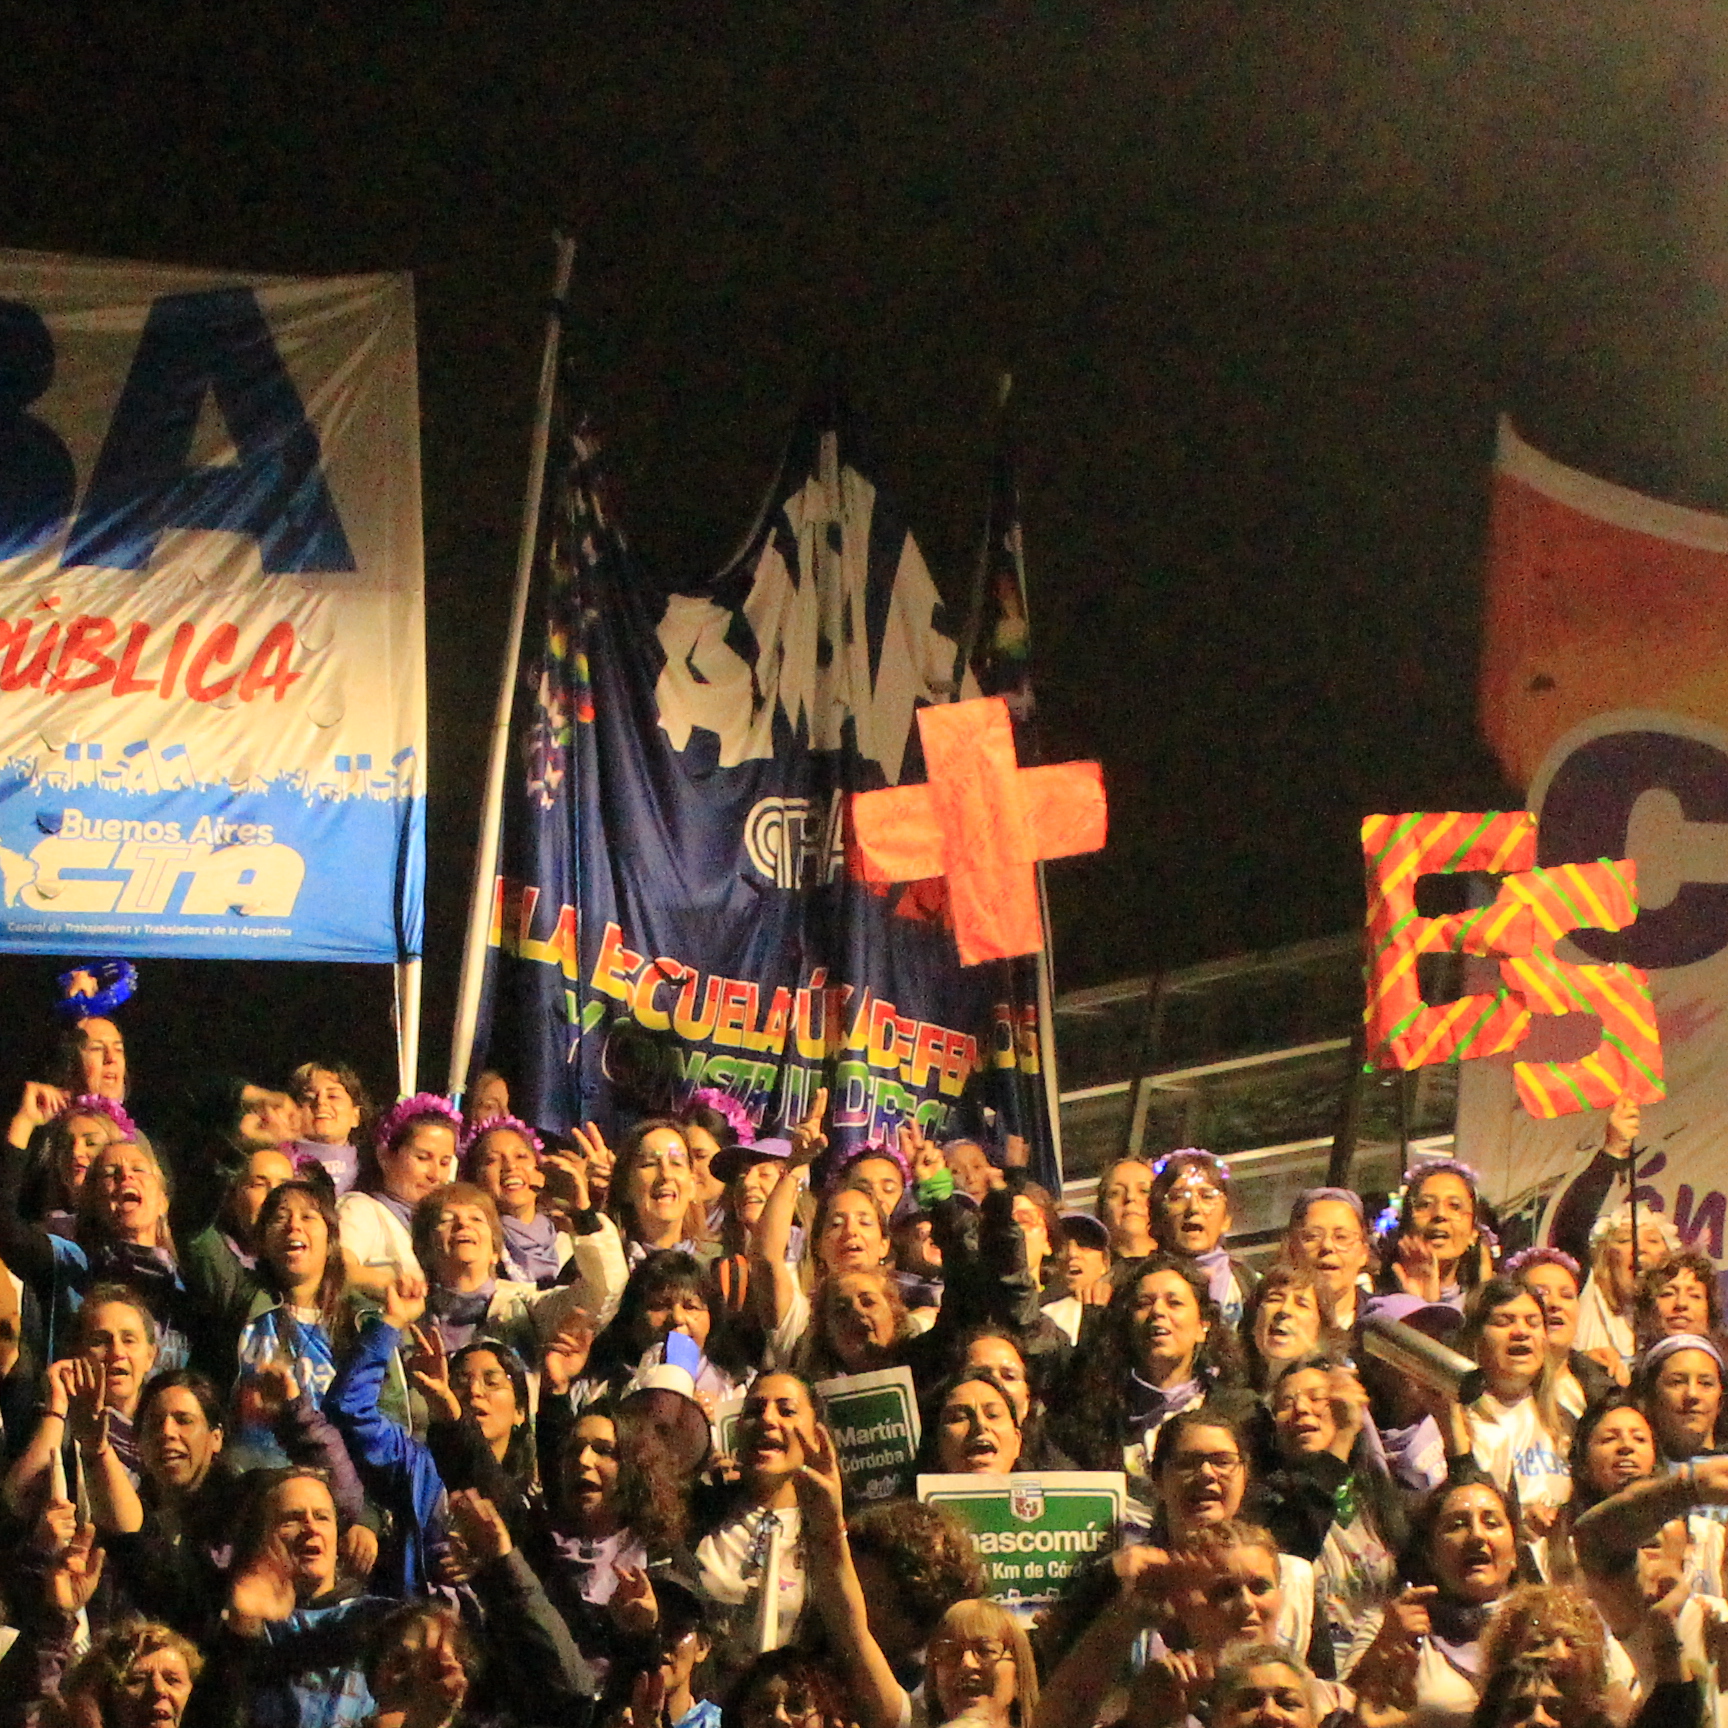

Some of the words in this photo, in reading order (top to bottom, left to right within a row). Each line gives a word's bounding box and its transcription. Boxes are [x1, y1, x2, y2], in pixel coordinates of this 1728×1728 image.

[58, 808, 182, 844] Buenos
[189, 815, 275, 846] Aires
[21, 838, 306, 918] CTA
[834, 1417, 908, 1448] Martín
[991, 1561, 1021, 1580] Km
[1024, 1560, 1045, 1580] de
